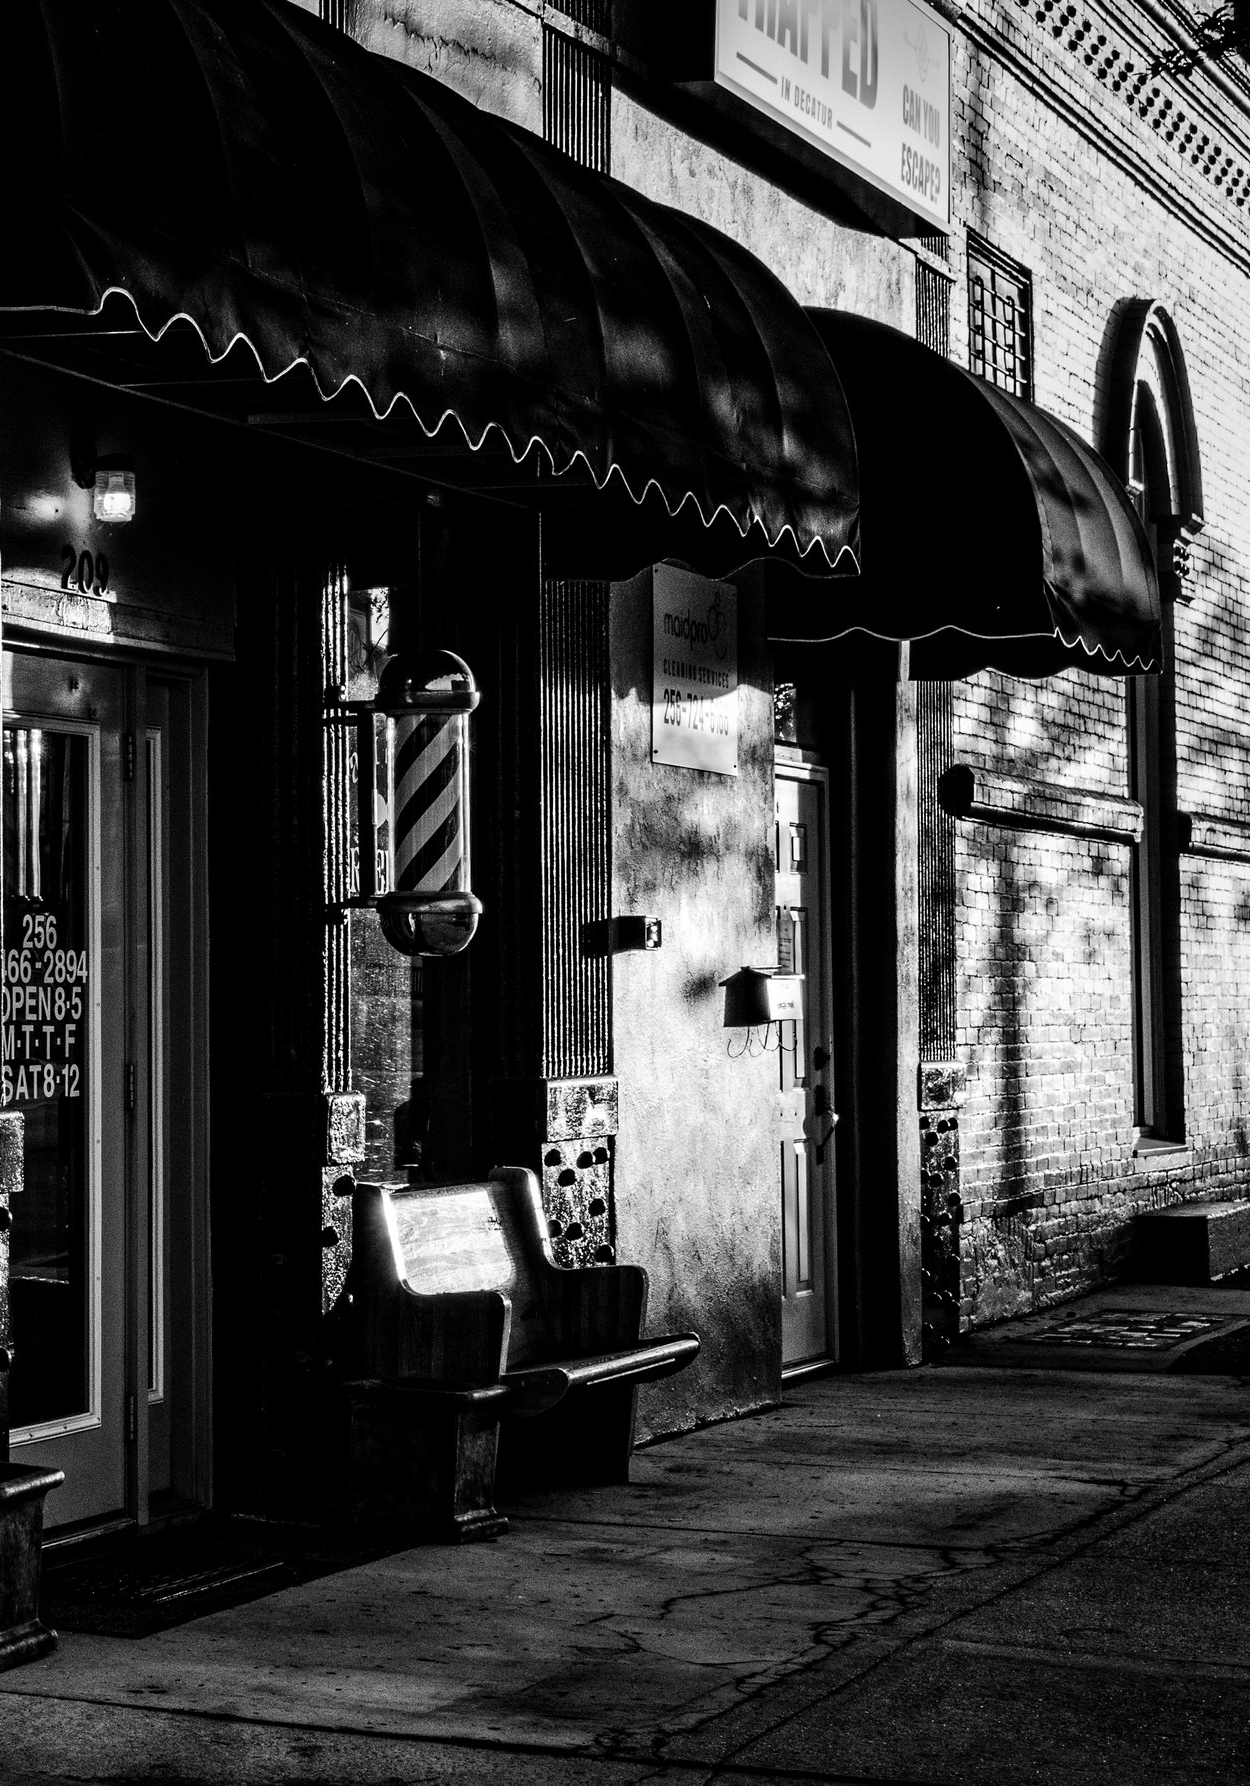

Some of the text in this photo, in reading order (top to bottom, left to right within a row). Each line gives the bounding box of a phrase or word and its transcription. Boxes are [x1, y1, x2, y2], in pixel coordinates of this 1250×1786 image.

[780, 76, 833, 131] IN DECATUR
[902, 84, 940, 149] CAN YOU
[901, 142, 941, 205] ESCAPE?
[60, 545, 109, 597] 209
[664, 609, 708, 652] maidpro
[663, 659, 729, 689] CLEANING SERVICES
[22, 914, 58, 950] 256
[2, 1064, 42, 1107] SAT
